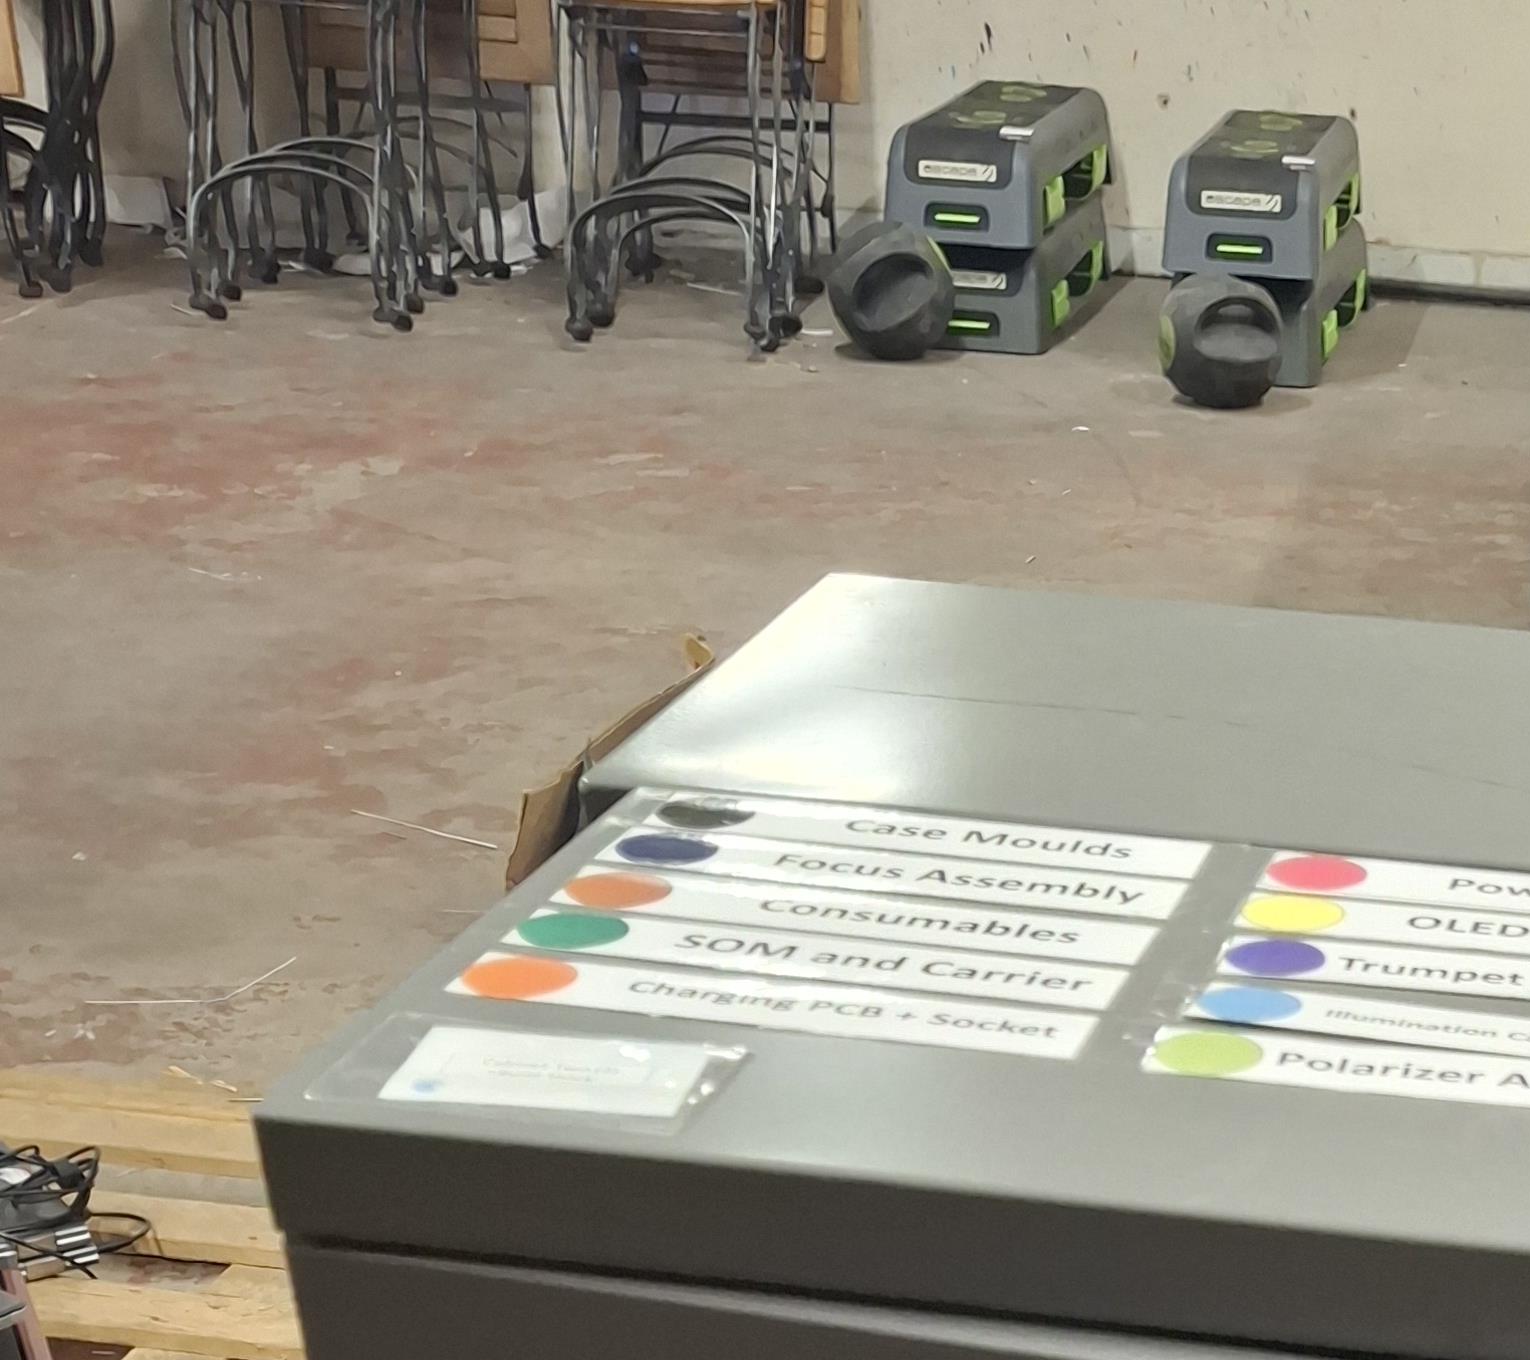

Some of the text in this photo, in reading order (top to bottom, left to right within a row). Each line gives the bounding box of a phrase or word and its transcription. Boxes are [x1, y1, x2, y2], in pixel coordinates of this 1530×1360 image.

[846, 819, 1135, 860] Case Moulds
[772, 853, 1148, 905] Focus Assembly
[759, 899, 1083, 945] Consumables
[1406, 914, 1530, 940] OLED
[675, 933, 1095, 993] SOM and Carrier
[1339, 956, 1523, 990] Trumpet
[628, 980, 794, 1012] Charging
[806, 999, 884, 1019] PCB
[926, 1011, 1059, 1039] Socket
[1323, 1008, 1497, 1039] Illumination
[1276, 1051, 1485, 1086] Polarizer
